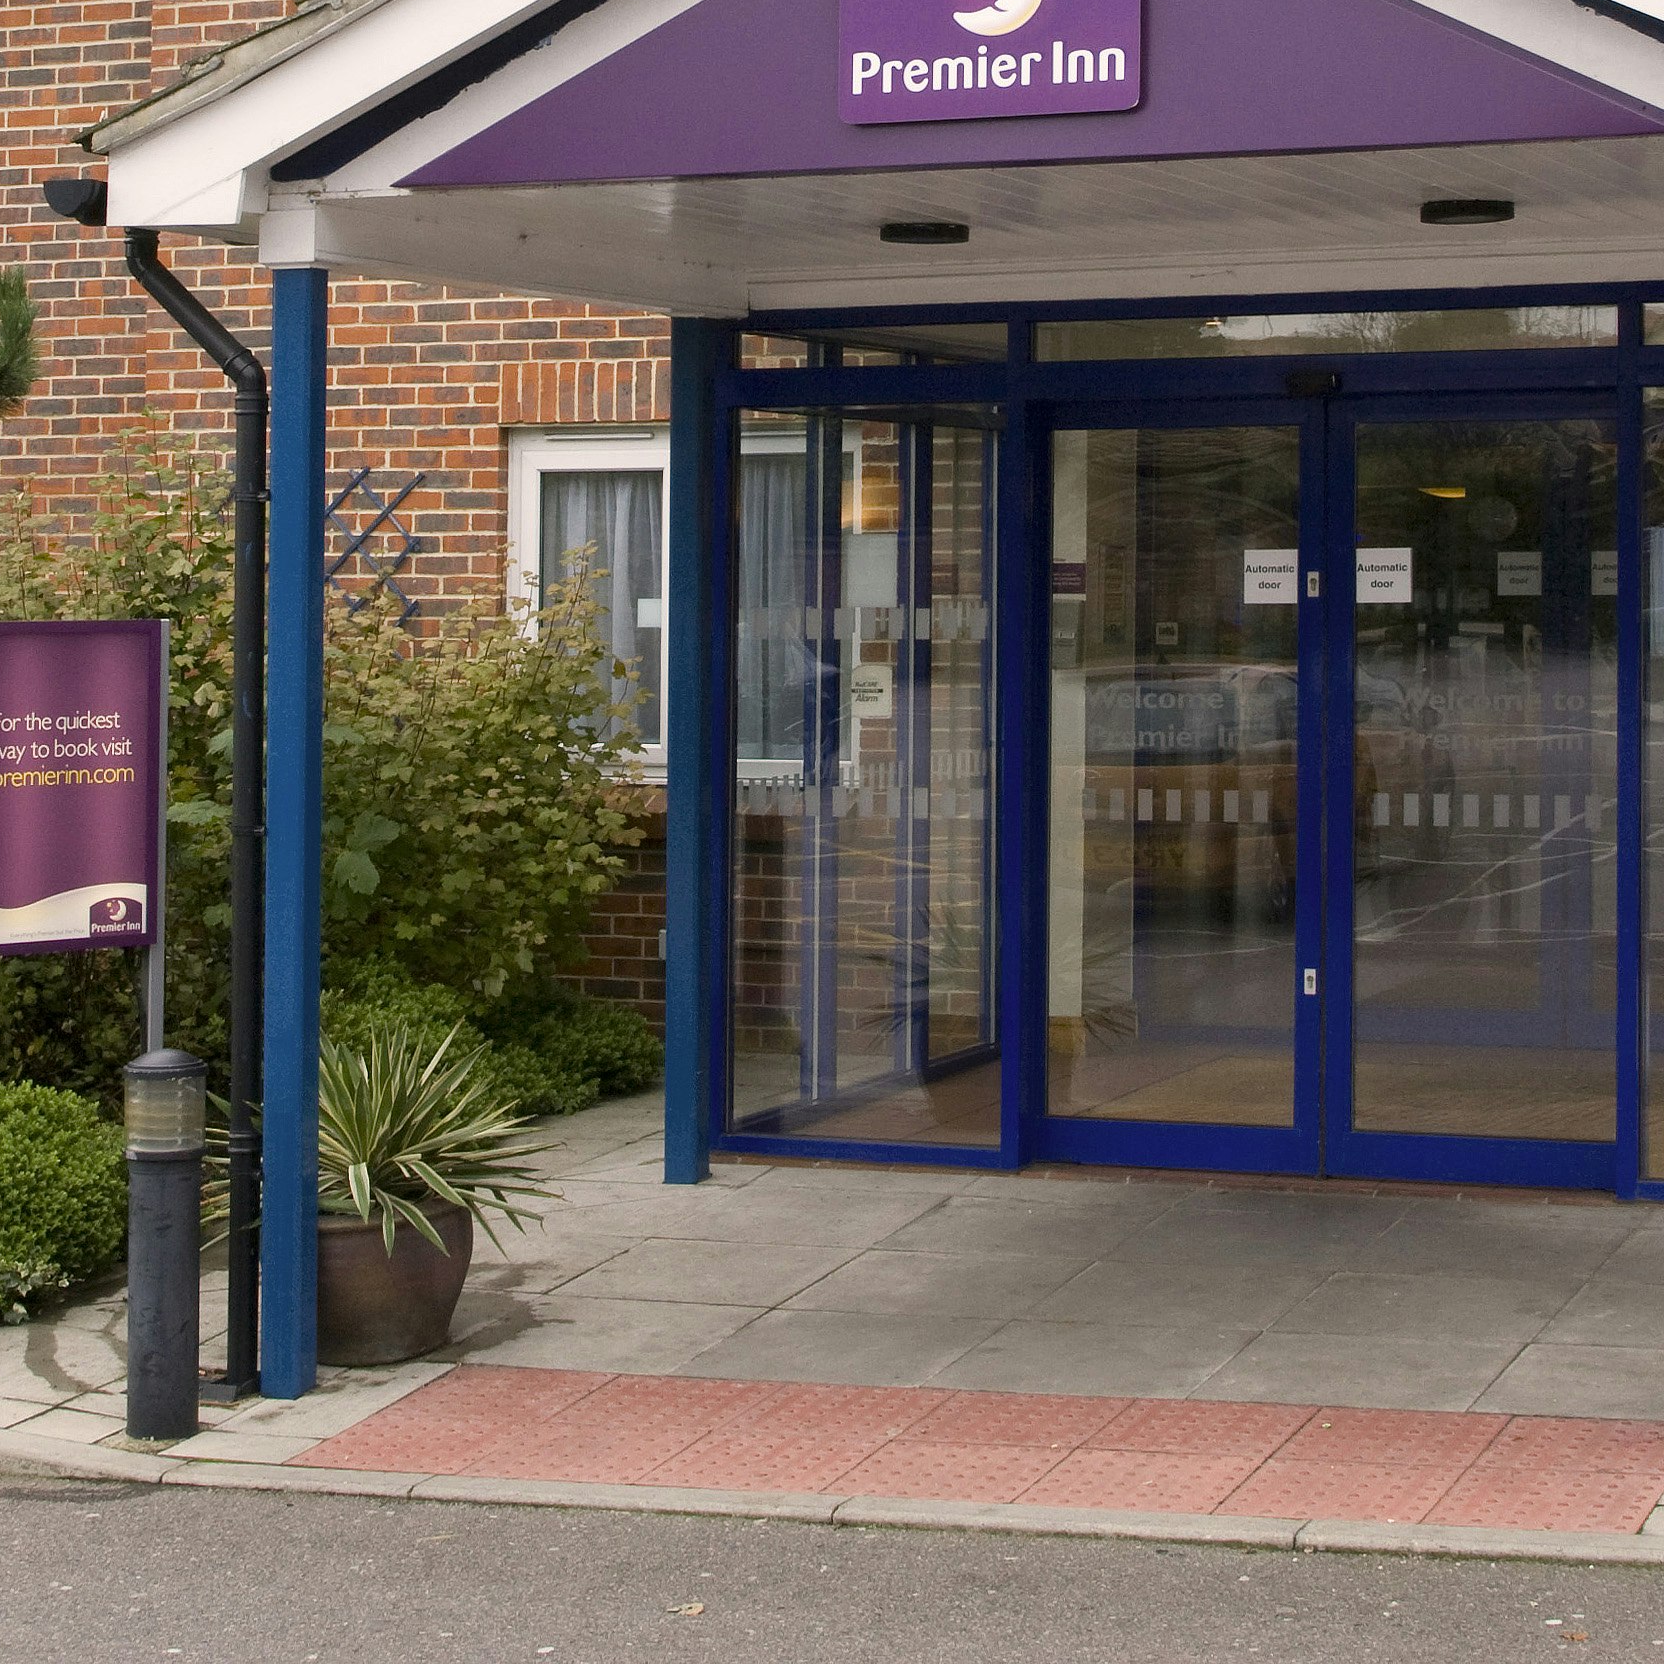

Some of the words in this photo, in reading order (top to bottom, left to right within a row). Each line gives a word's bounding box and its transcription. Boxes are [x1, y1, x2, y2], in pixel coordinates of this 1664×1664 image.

[851, 45, 1042, 95] Premier
[1052, 40, 1126, 84] Inn
[1245, 564, 1295, 574] Automatic
[1357, 562, 1407, 573] Automatic
[1258, 580, 1281, 590] door
[1370, 579, 1394, 589] door
[24, 711, 52, 731] the
[55, 710, 121, 735] quickest
[30, 741, 50, 760] to
[54, 738, 99, 758] book
[101, 736, 133, 756] visit
[91, 923, 127, 933] Premier
[126, 921, 141, 931] Inn
